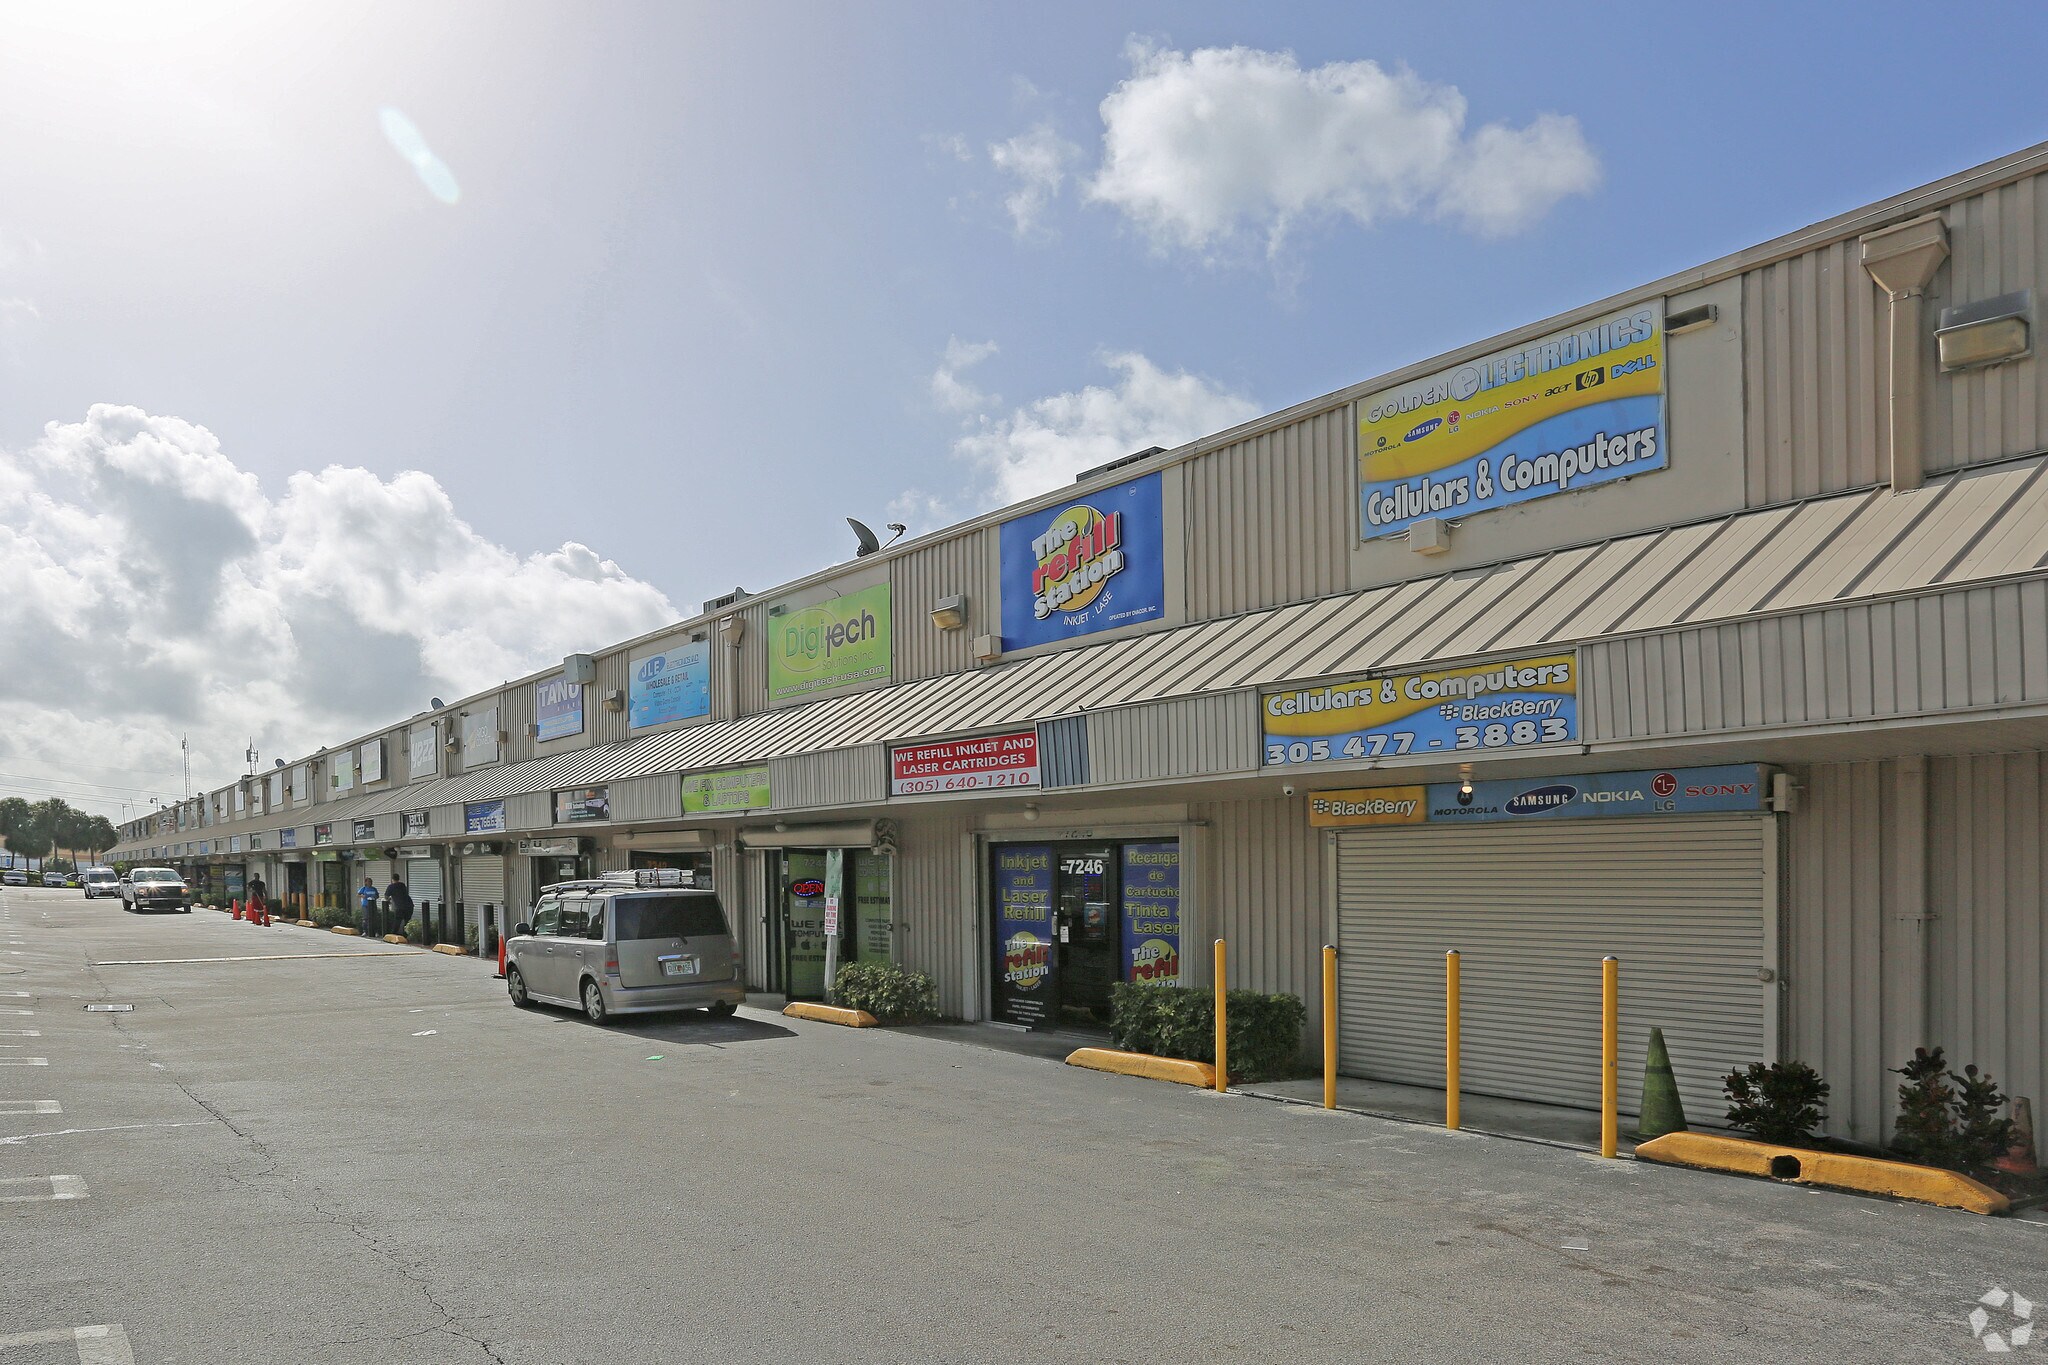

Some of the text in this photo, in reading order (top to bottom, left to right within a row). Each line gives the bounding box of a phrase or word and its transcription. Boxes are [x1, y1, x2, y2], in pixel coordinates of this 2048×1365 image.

[1611, 354, 1656, 380] DELL
[1544, 381, 1572, 397] acer
[1367, 382, 1450, 423] GOLDEN
[1504, 393, 1539, 409] SONY
[1465, 405, 1500, 420] NOKIA
[1407, 422, 1439, 438] SAMSUNG
[1448, 425, 1460, 434] LG
[1364, 442, 1401, 457] MOTOROLA
[1366, 427, 1656, 526] Cellulars & Computers
[1032, 520, 1078, 561] The
[1032, 511, 1121, 597] refill
[1063, 611, 1089, 626] INKJET
[640, 660, 661, 679] JLE
[646, 677, 670, 690] WHOLESALE
[675, 672, 689, 683] RETAIL
[776, 664, 886, 696] www.digitech-usa.com
[1267, 663, 1569, 716] Cellulars & Computers
[1461, 698, 1562, 722] BlackBerry
[895, 737, 1035, 762] WE REFILL INKJET AND
[1267, 740, 1330, 765] 305
[1342, 732, 1415, 758] 477
[1456, 718, 1569, 750] 3883
[903, 753, 1026, 775] LASER CARTRIDGES
[716, 772, 768, 790] COMPUTERS
[900, 771, 1030, 793] (305) 640-1210
[712, 790, 749, 806] LAPTOPS
[1582, 790, 1644, 803] NOKIA
[1685, 783, 1755, 798] SONY
[1331, 799, 1417, 817] BlackBerry
[1513, 793, 1568, 807] SAMSUNG
[1654, 800, 1676, 812] LG
[1433, 806, 1498, 816] MOTOROLA
[1001, 853, 1048, 873] Inkjet
[1013, 876, 1034, 886] and
[1149, 871, 1165, 880] de
[793, 883, 824, 893] OPEN
[1002, 889, 1048, 903] Laser
[1003, 905, 1046, 921] Refill
[1125, 902, 1169, 917] Tinta
[791, 920, 815, 928] WE
[1005, 938, 1027, 951] The
[1132, 946, 1160, 961] The
[1004, 965, 1049, 983] station
[1130, 954, 1179, 982] refil
